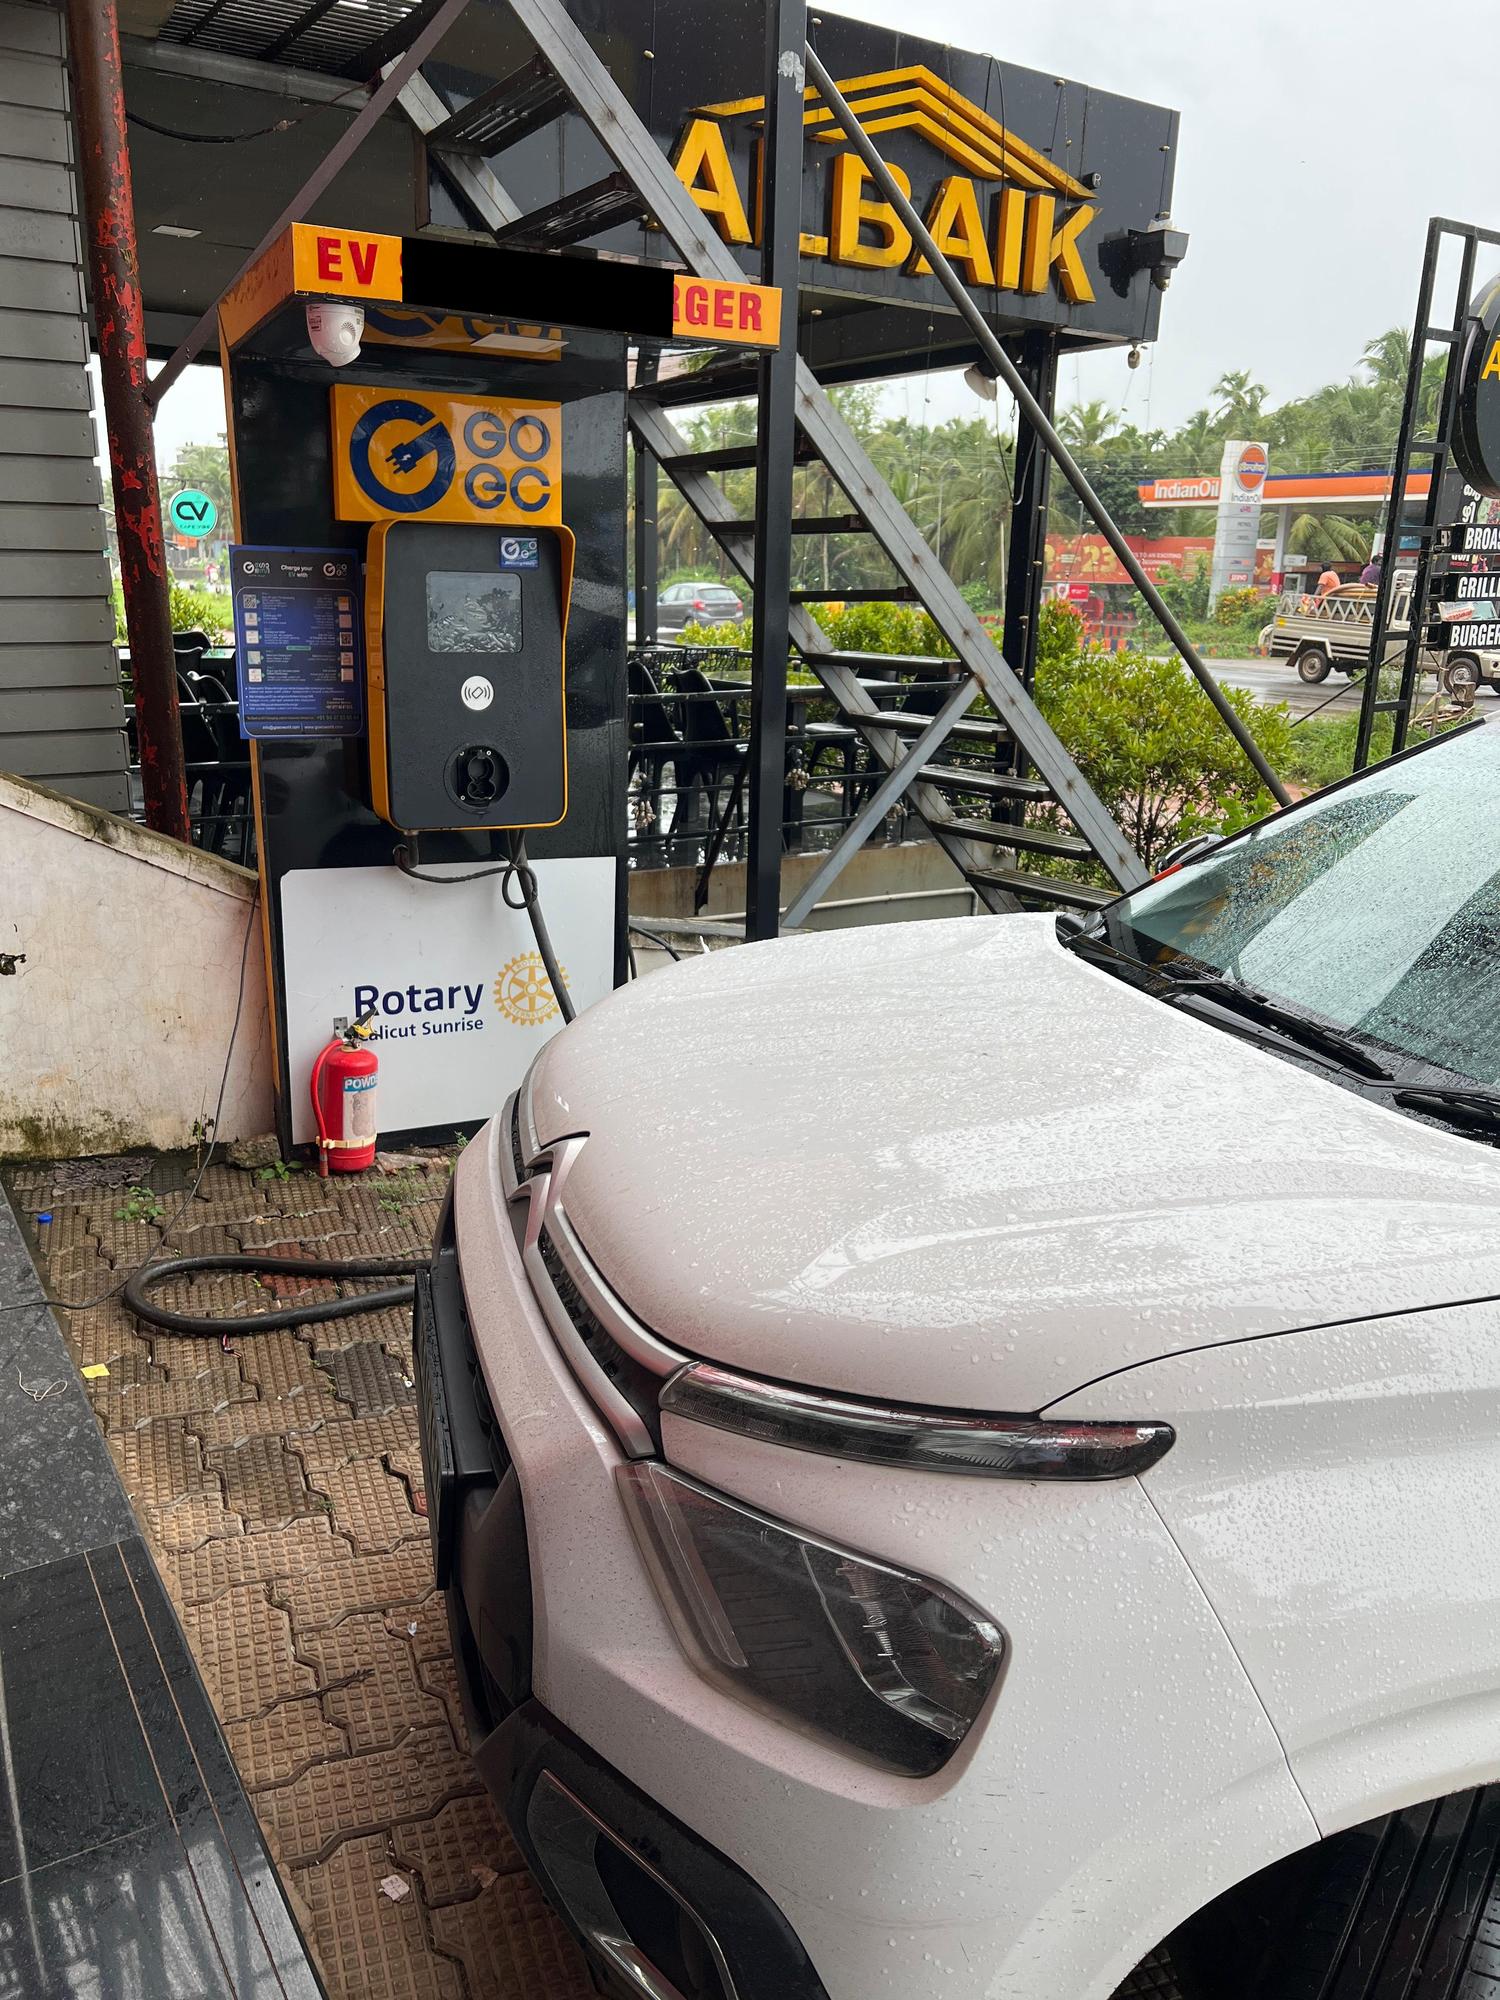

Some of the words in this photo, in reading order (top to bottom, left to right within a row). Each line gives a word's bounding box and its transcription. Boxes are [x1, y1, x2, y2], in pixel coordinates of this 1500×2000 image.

[317, 236, 379, 285] EV
[463, 411, 551, 462] GO
[1154, 480, 1220, 499] IndianOil
[176, 501, 209, 521] CV
[1464, 527, 1500, 550] BROA
[1082, 545, 1118, 572] 23
[1457, 576, 1500, 599] GRILL
[354, 984, 484, 1018] Rotary
[359, 1024, 416, 1042] alicut
[422, 1018, 484, 1035] Sunrise
